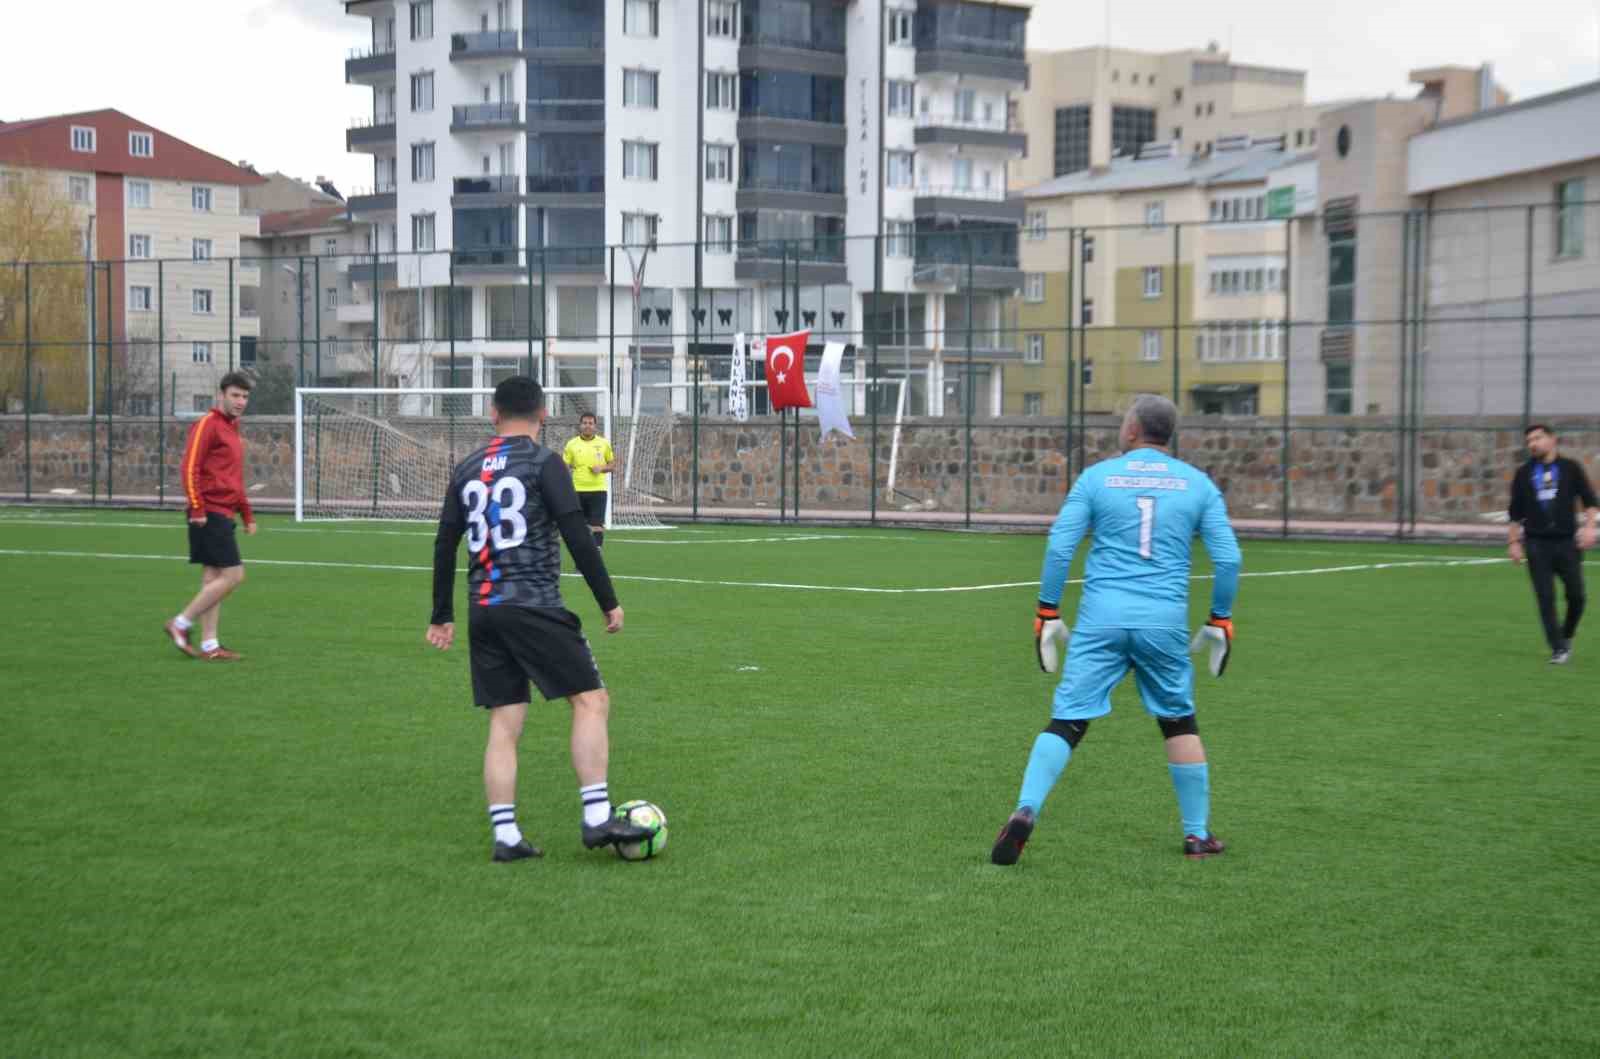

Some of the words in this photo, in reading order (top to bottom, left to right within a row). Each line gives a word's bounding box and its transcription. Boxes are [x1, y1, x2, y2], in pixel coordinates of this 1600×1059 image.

[482, 455, 508, 471] CAN
[462, 476, 527, 552] 33
[1136, 496, 1154, 559] 1
